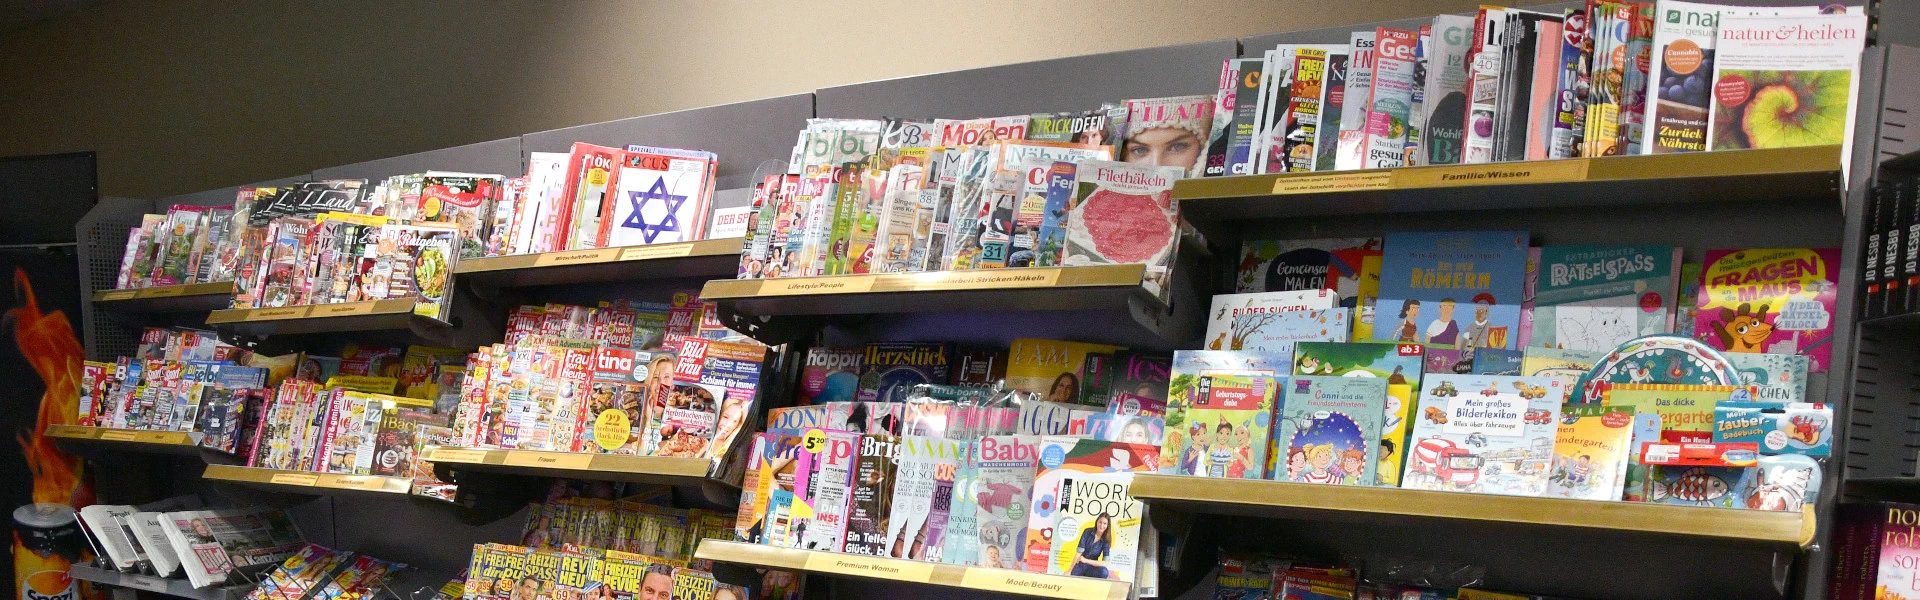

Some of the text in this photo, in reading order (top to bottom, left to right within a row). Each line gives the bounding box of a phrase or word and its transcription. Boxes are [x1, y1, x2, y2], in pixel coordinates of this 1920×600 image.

[1477, 59, 1493, 69] 40
[1659, 125, 1703, 139] Zurück
[1097, 168, 1166, 187] Filethäkeln
[1442, 169, 1531, 181] Familie/Wissen
[919, 195, 932, 204] 38
[717, 211, 735, 226] DER
[984, 244, 1002, 258] 31
[1410, 268, 1491, 289] RÖMERN
[1711, 255, 1818, 289] FRAGEN
[787, 281, 844, 290] Lifestyle/People
[1738, 279, 1802, 302] MAUS
[681, 340, 707, 358] Bild
[864, 345, 947, 366] Herzstück
[1400, 344, 1420, 354] ab 3
[565, 349, 589, 365] Frau
[598, 351, 633, 371] tina
[562, 368, 587, 381] Heute
[701, 374, 756, 390] Schlank für immer
[1315, 389, 1339, 399] Conni
[1465, 398, 1512, 410] Mein großes
[1656, 397, 1695, 406] Das dicke
[605, 413, 621, 426] 22
[1455, 407, 1517, 420] Bilderlexikon
[1717, 415, 1771, 433] Zauber-
[1680, 435, 1692, 443] Ein
[1073, 498, 1134, 519] BOOK
[847, 531, 887, 544] Ein Telle
[846, 543, 873, 556] Glück,
[605, 562, 643, 579] FREIZEIT
[836, 560, 900, 574] Premium Woman
[674, 574, 714, 589] FREIZEIT
[1005, 577, 1063, 592] Mode/Beauty
